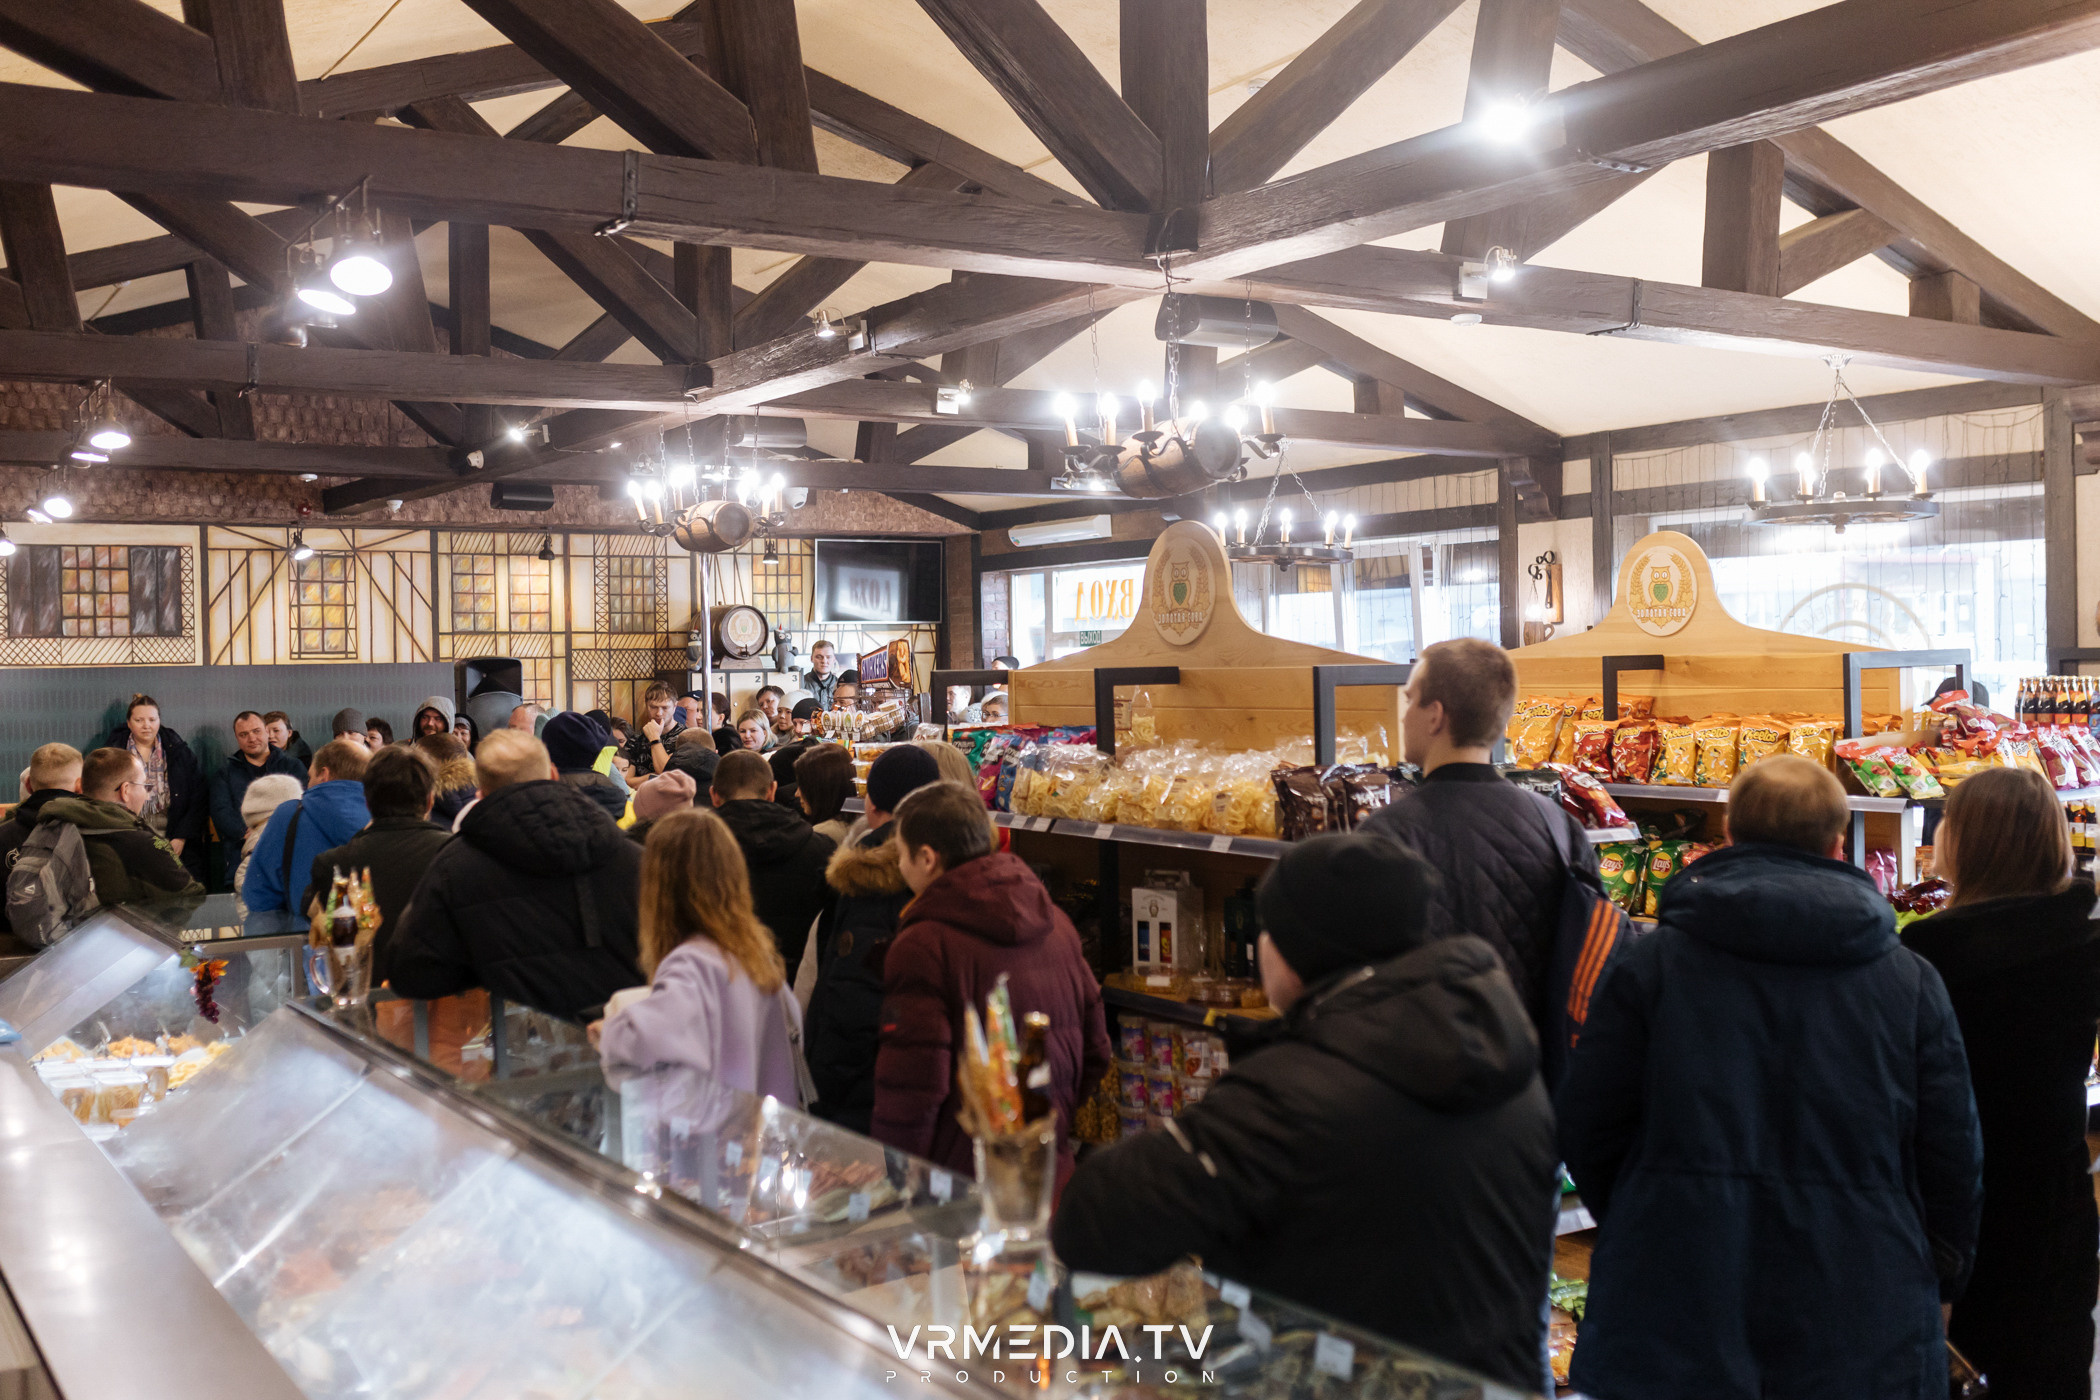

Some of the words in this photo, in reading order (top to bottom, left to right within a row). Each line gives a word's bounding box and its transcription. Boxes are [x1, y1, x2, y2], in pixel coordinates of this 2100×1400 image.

[1080, 630, 1101, 645] ВЫХОД
[861, 651, 887, 682] SNICKERS
[718, 676, 724, 684] 1
[755, 675, 761, 683] 2
[792, 674, 798, 683] 3
[1739, 728, 1778, 746] Cheetos
